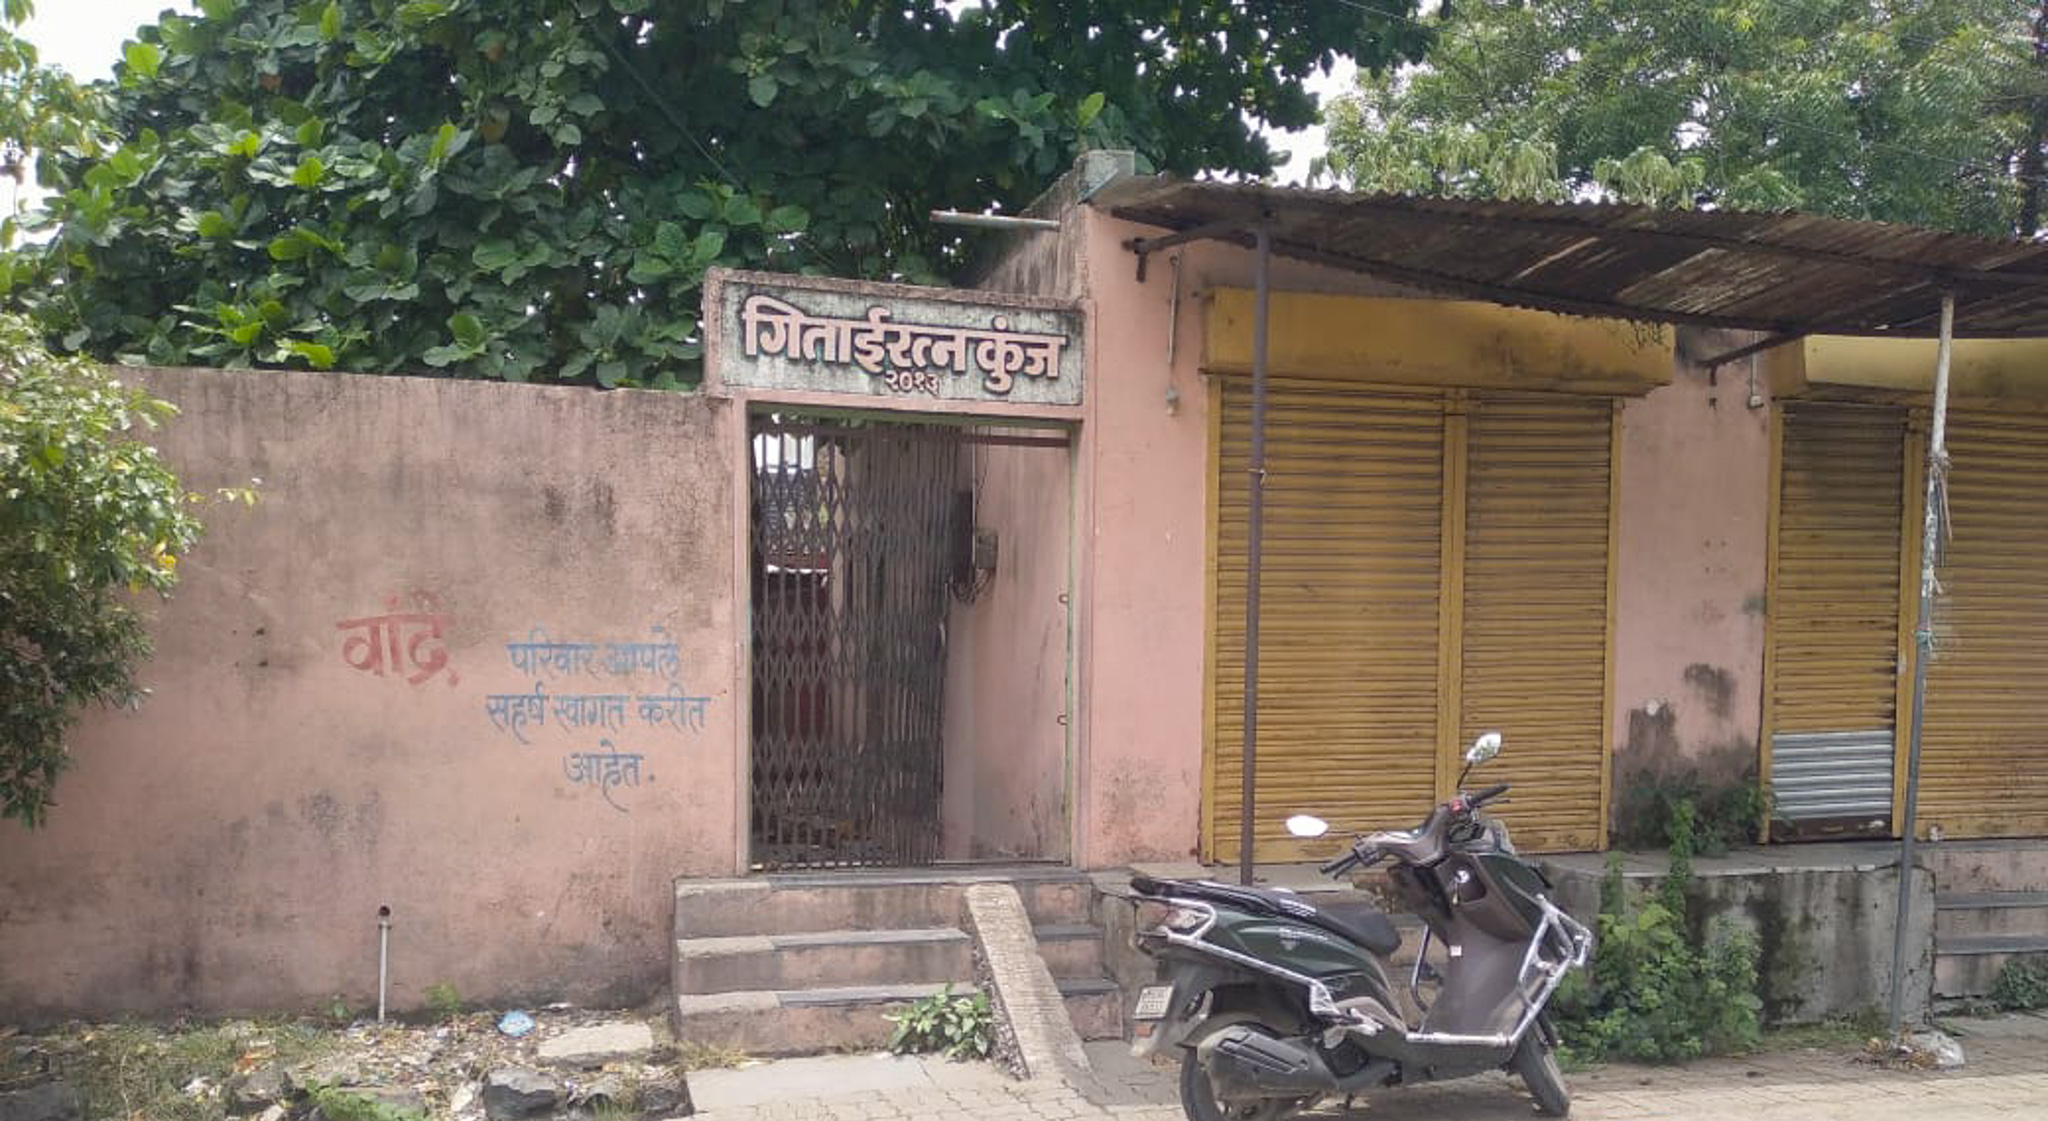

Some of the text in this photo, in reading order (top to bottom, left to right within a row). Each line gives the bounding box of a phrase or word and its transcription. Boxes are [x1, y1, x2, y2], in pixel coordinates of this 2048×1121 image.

[884, 369, 940, 396] २०१३
[504, 626, 600, 681] परिवार
[486, 680, 711, 745] सहर्ष स्वागत करीत
